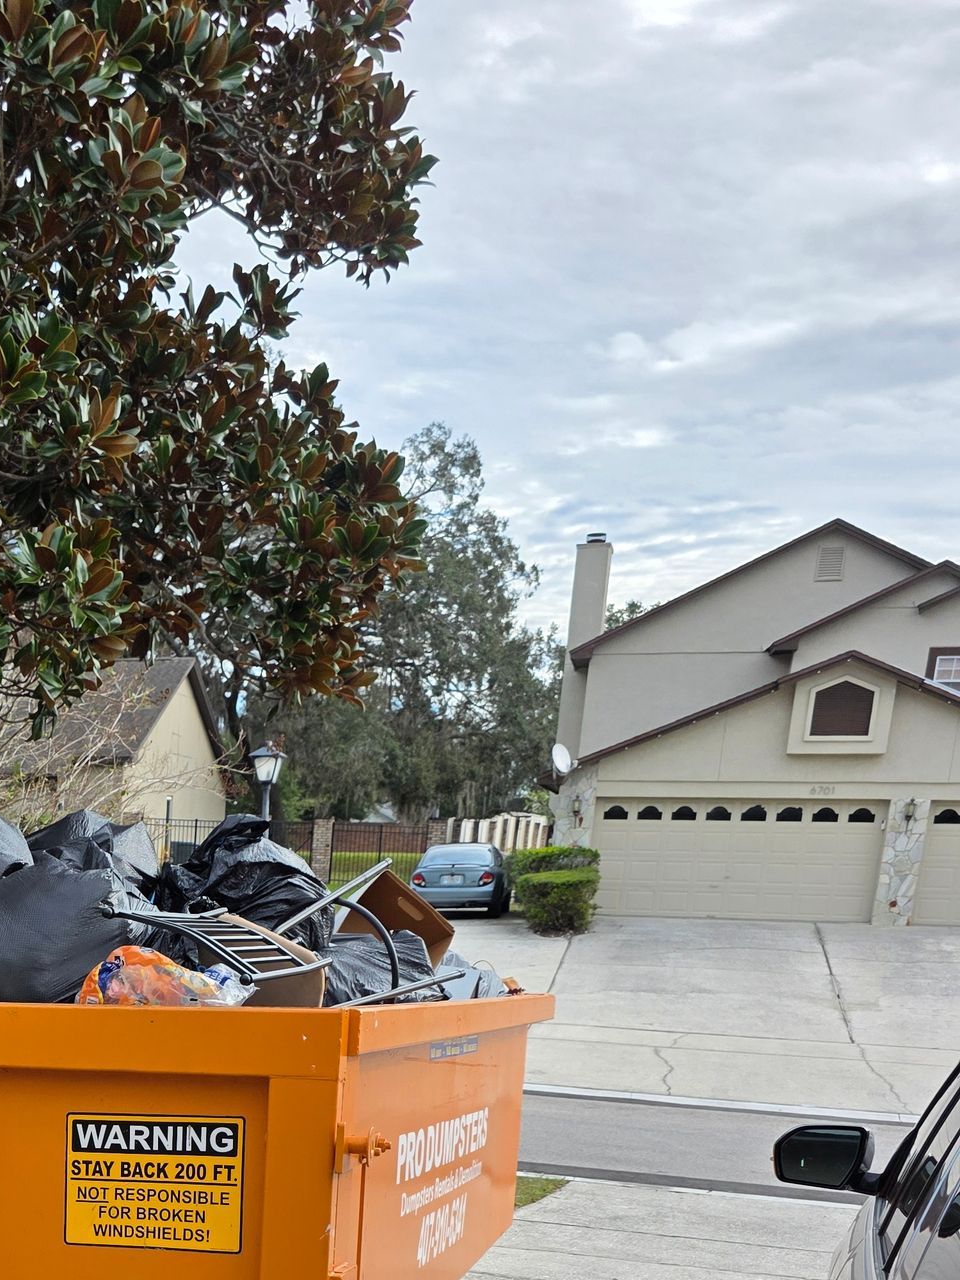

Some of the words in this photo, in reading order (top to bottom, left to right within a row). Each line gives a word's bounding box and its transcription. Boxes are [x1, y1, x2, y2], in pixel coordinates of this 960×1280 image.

[809, 786, 836, 796] 6701
[76, 1123, 234, 1153] WARNING
[71, 1160, 115, 1177] STAY
[120, 1161, 169, 1179] BACK
[175, 1163, 207, 1181] 200
[213, 1164, 238, 1182] FT.
[77, 1186, 109, 1200] NOT
[114, 1187, 230, 1206] RESPONSIBLE
[98, 1205, 131, 1220] FOR
[136, 1208, 206, 1223] BROKEN
[93, 1223, 210, 1243] WINDSHIELDS!
